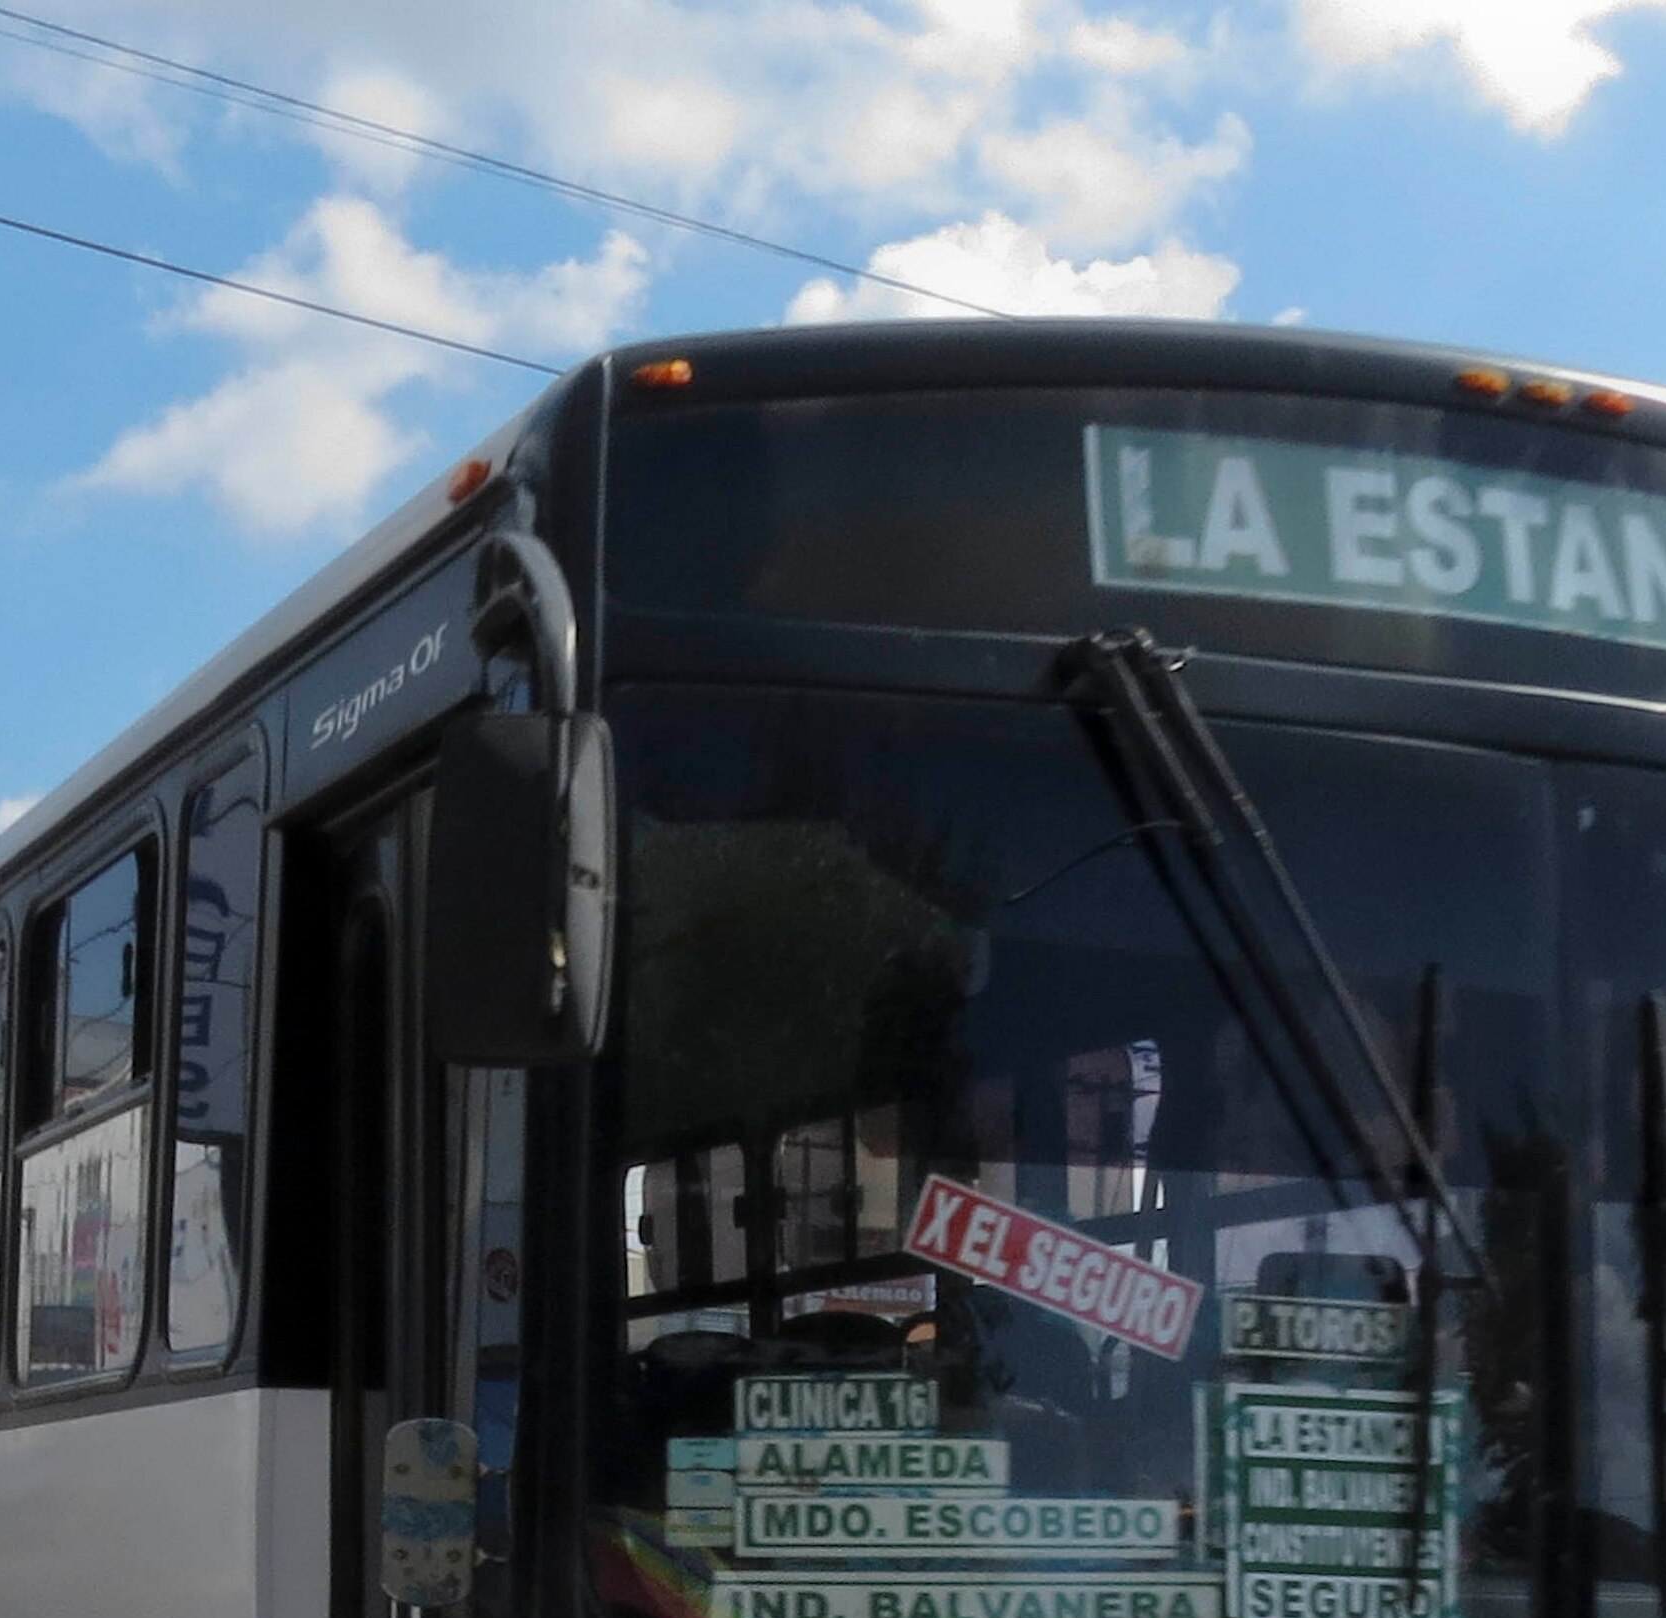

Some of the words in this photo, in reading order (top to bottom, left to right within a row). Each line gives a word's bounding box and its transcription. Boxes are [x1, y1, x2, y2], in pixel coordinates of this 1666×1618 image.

[1118, 444, 1290, 578] LA
[309, 663, 406, 750] Sigma
[917, 1188, 963, 1255] X
[960, 1208, 1013, 1278] EL
[1018, 1228, 1185, 1346] SEGURO
[1235, 1301, 1264, 1346] P.
[1270, 1303, 1400, 1355] TOROS
[747, 1381, 882, 1430] CLINICA
[1296, 1411, 1433, 1456] ESTANC
[755, 1442, 991, 1478] ALAMEDA
[763, 1502, 887, 1539] MDO.
[905, 1503, 1163, 1540] ESCOBEDO
